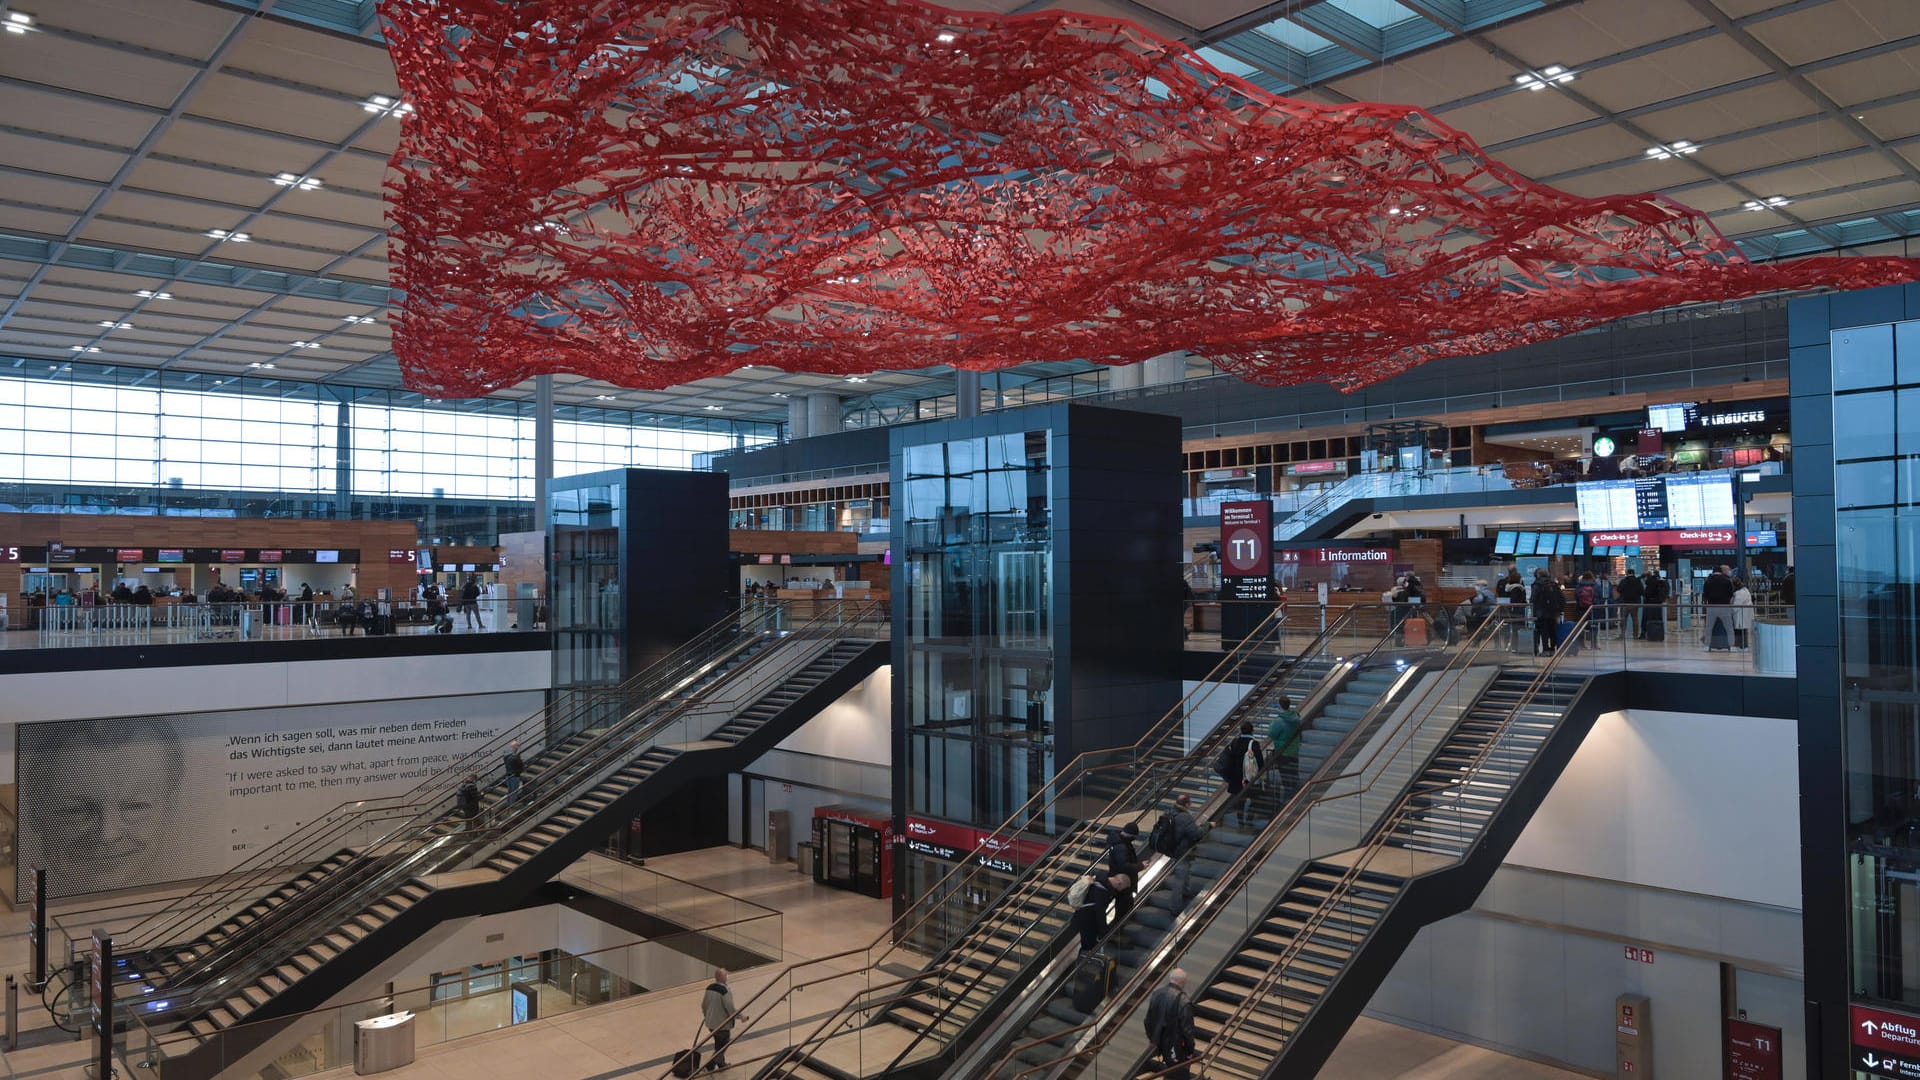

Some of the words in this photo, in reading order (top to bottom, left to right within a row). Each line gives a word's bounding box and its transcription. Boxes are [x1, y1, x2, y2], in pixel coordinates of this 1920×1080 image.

[1701, 411, 1765, 426] TARBUCKS
[9, 548, 18, 560] 5
[408, 550, 415, 561] 5
[1232, 539, 1255, 560] T1
[1328, 549, 1387, 560] Information
[264, 733, 279, 743] ich
[282, 731, 312, 742] sagen
[315, 728, 335, 739] soll,
[338, 727, 358, 736] was
[360, 726, 377, 736] mir
[380, 724, 409, 734] neben
[411, 722, 431, 731] dem
[434, 720, 467, 729] Frieden
[230, 750, 248, 760] das
[251, 745, 306, 758] Wichtigste
[308, 743, 325, 754] sei,
[328, 741, 353, 752] dann
[355, 738, 384, 750] lautet
[387, 736, 416, 746] meine
[247, 770, 273, 780] were
[276, 766, 305, 778] asked
[308, 765, 319, 774] to
[321, 763, 337, 774] say
[370, 758, 394, 770] apart
[396, 756, 420, 766] from
[422, 754, 449, 764] peace,
[230, 784, 283, 798] important
[285, 782, 296, 790] to
[298, 780, 317, 790] me,
[320, 777, 343, 788] then
[345, 776, 362, 786] my
[364, 772, 398, 783] answer
[400, 768, 428, 779] would
[1880, 1022, 1916, 1038] Abflug
[1755, 1038, 1770, 1052] T1
